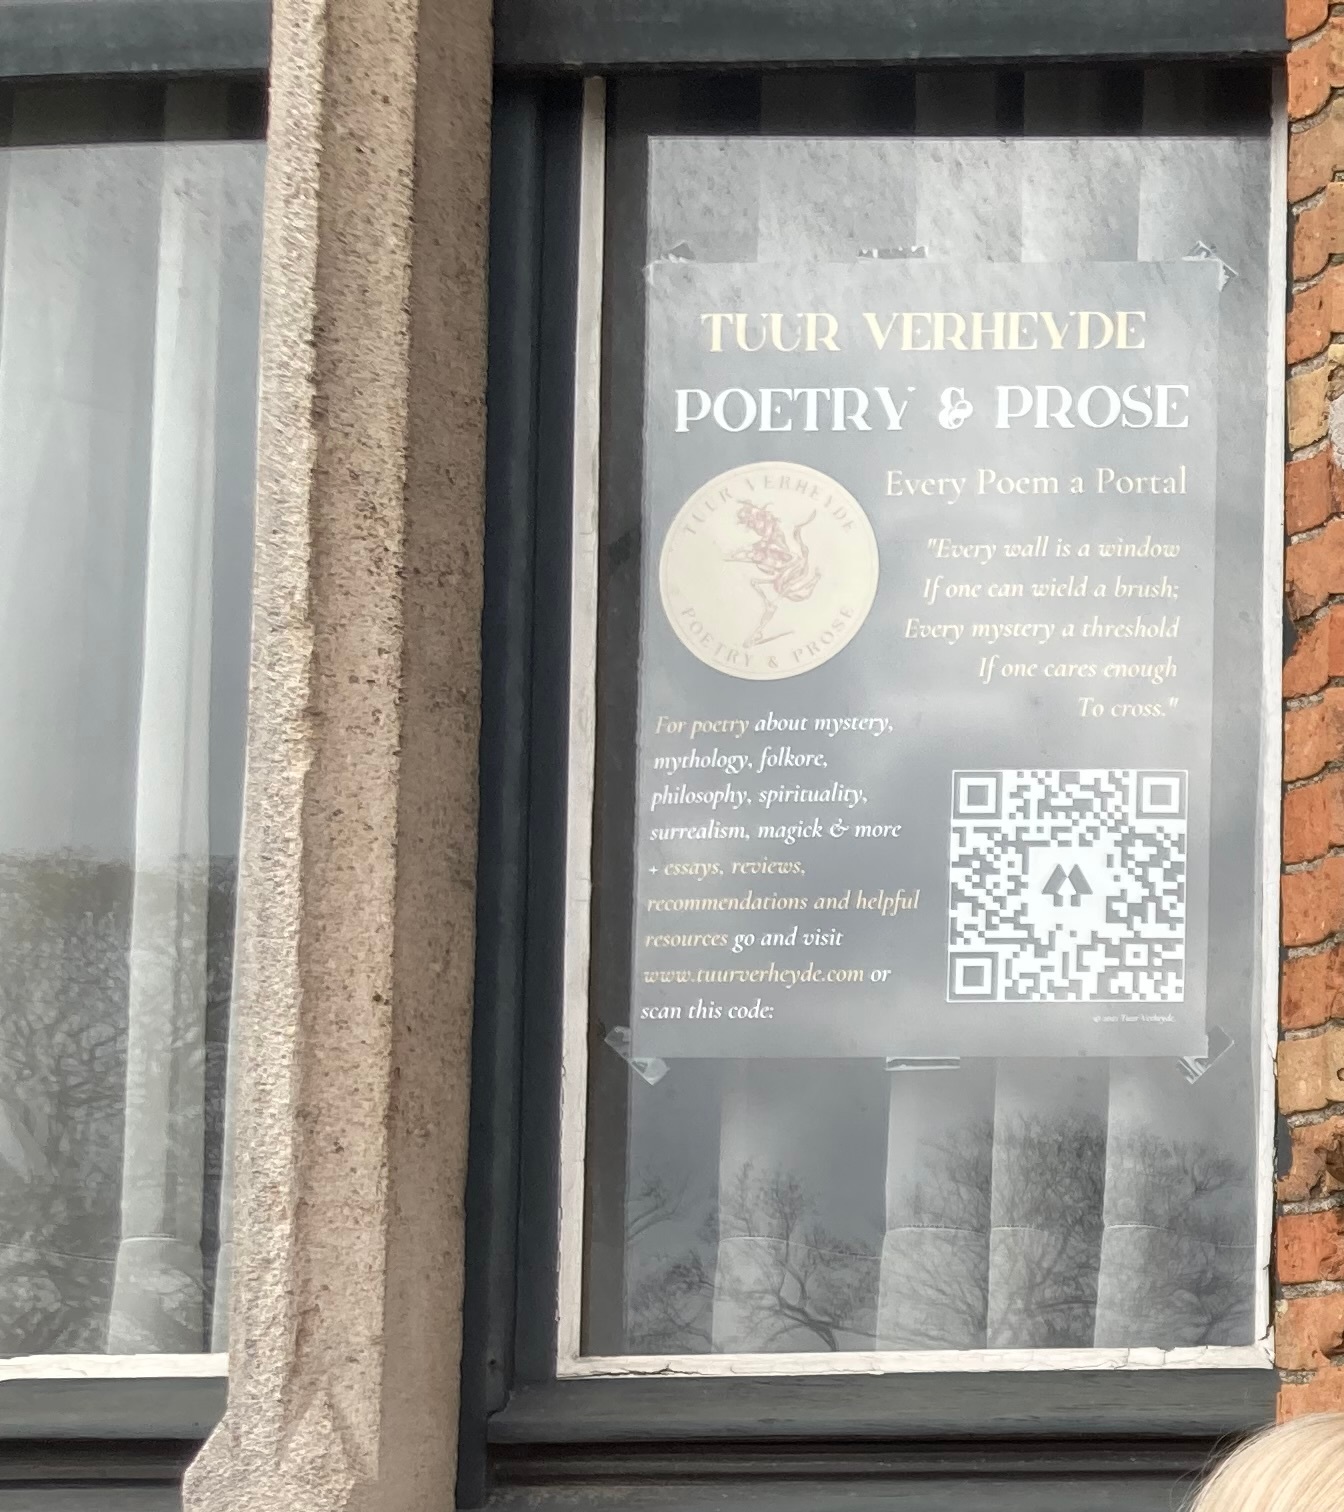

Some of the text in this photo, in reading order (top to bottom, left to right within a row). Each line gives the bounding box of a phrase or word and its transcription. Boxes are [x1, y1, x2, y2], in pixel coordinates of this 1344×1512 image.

[700, 311, 1146, 352] TUUR VERHEYDE
[674, 384, 1189, 433] POETRY & PROSE
[885, 465, 1187, 505] Every Poem a Portal
[927, 535, 1181, 565] "Every wall is a window
[923, 575, 1179, 605] If one can wield a brush;
[681, 606, 855, 669] POETRY & PROSE
[905, 615, 1181, 645] Every mystery a threshold
[978, 654, 1178, 684] If one cares enough
[1078, 696, 1179, 718] To cross."
[655, 712, 894, 739] For poetry about mystery,
[653, 746, 828, 775] mythology, folkore,
[650, 781, 868, 811] philosophy, spirituality,
[650, 818, 902, 845] surrealism, magick & more
[648, 856, 806, 882] + essays, reviews,
[647, 888, 920, 917] recommendations and helpful
[645, 926, 843, 953] resources go and visit
[643, 962, 891, 989] www.tuurverheyde.com or
[640, 999, 774, 1020] scan this code:
